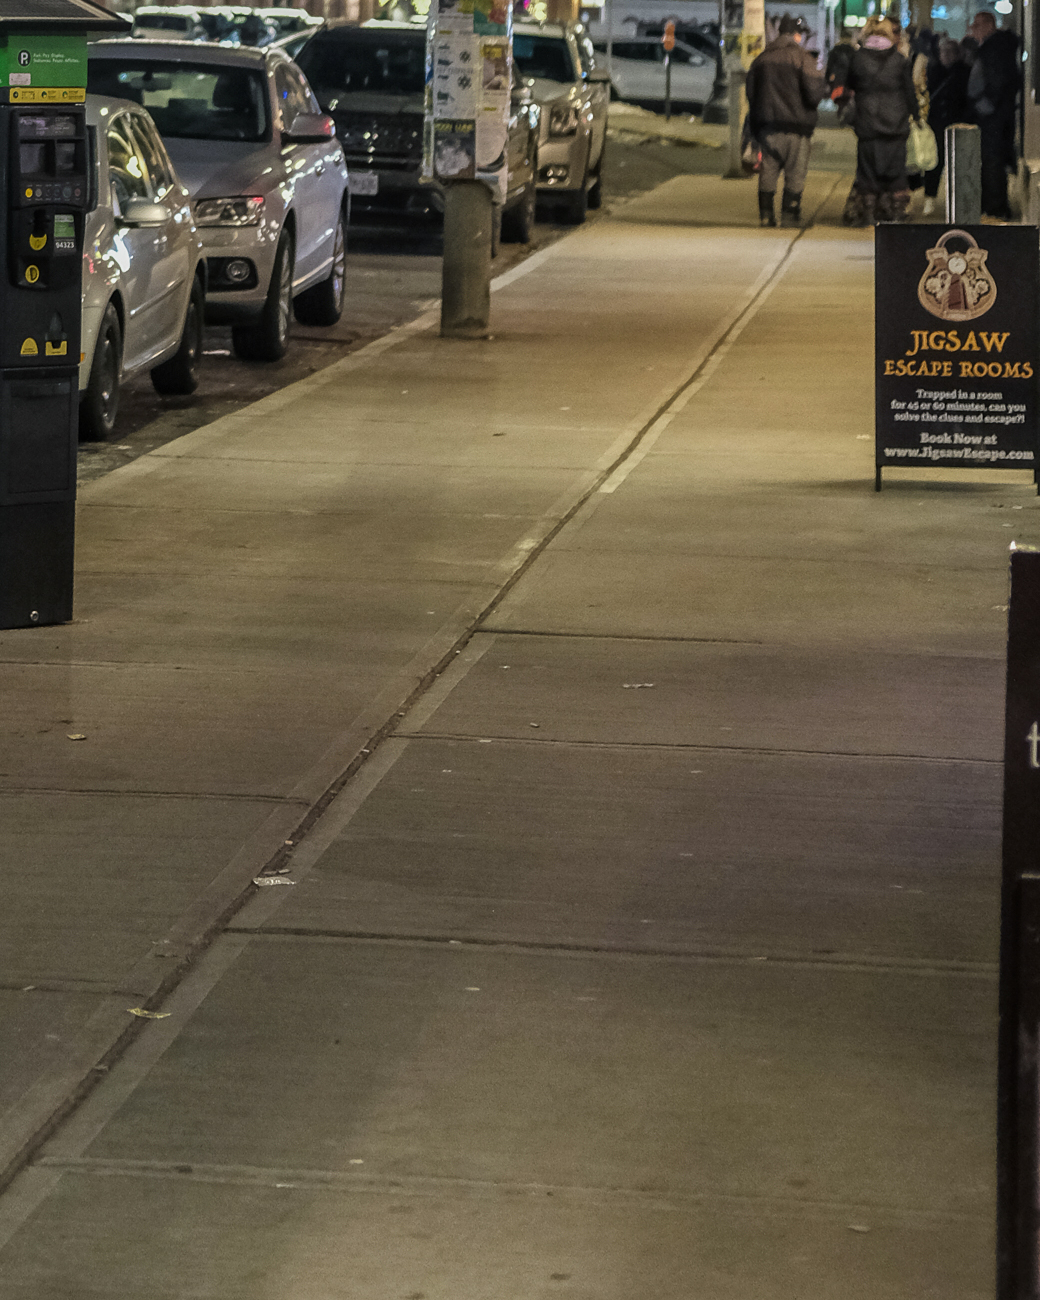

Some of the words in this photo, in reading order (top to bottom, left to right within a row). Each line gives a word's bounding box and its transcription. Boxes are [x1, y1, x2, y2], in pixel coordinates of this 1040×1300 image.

[55, 241, 75, 249] 94323
[905, 329, 1011, 356] JIGSAW
[883, 359, 953, 377] ESCAPE
[958, 360, 1034, 379] ROOMS
[916, 388, 957, 400] Trapped
[958, 389, 968, 399] in
[977, 392, 1003, 400] room
[890, 399, 906, 410] for
[919, 402, 931, 410] or
[988, 404, 1007, 412] can
[1007, 404, 1027, 414] you
[894, 411, 919, 422] solve
[921, 411, 937, 422] the
[938, 412, 963, 422] clues
[964, 413, 983, 423] and
[919, 432, 952, 444] Book
[953, 433, 983, 445] Now
[983, 434, 998, 445] at
